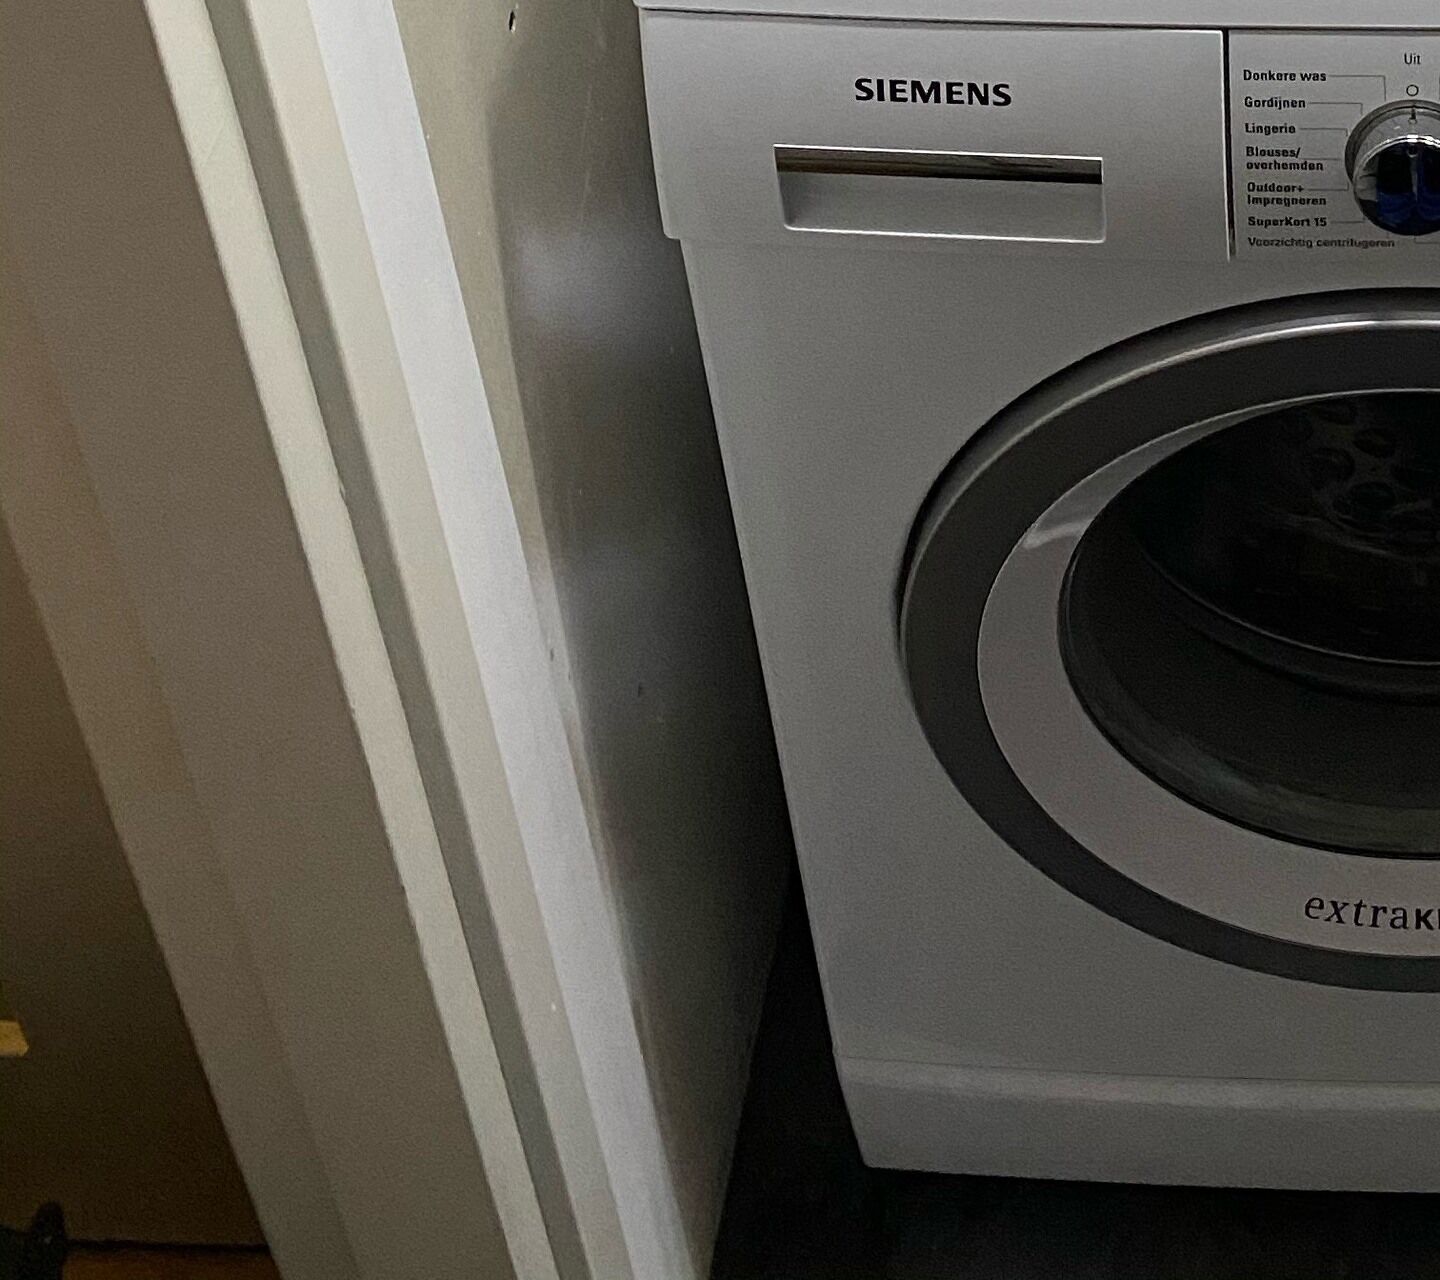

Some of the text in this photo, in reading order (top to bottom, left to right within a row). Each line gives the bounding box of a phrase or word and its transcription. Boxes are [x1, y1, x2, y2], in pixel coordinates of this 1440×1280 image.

[1403, 53, 1421, 65] Uit
[1243, 70, 1327, 82] Donkere was
[854, 77, 1012, 107] SIEMENS
[1244, 96, 1306, 110] Gordijnen
[1245, 123, 1296, 135] Lingerie
[1246, 146, 1301, 158] Blouses/
[1246, 160, 1324, 171] overhemden
[1248, 216, 1327, 229] SuperKort 15
